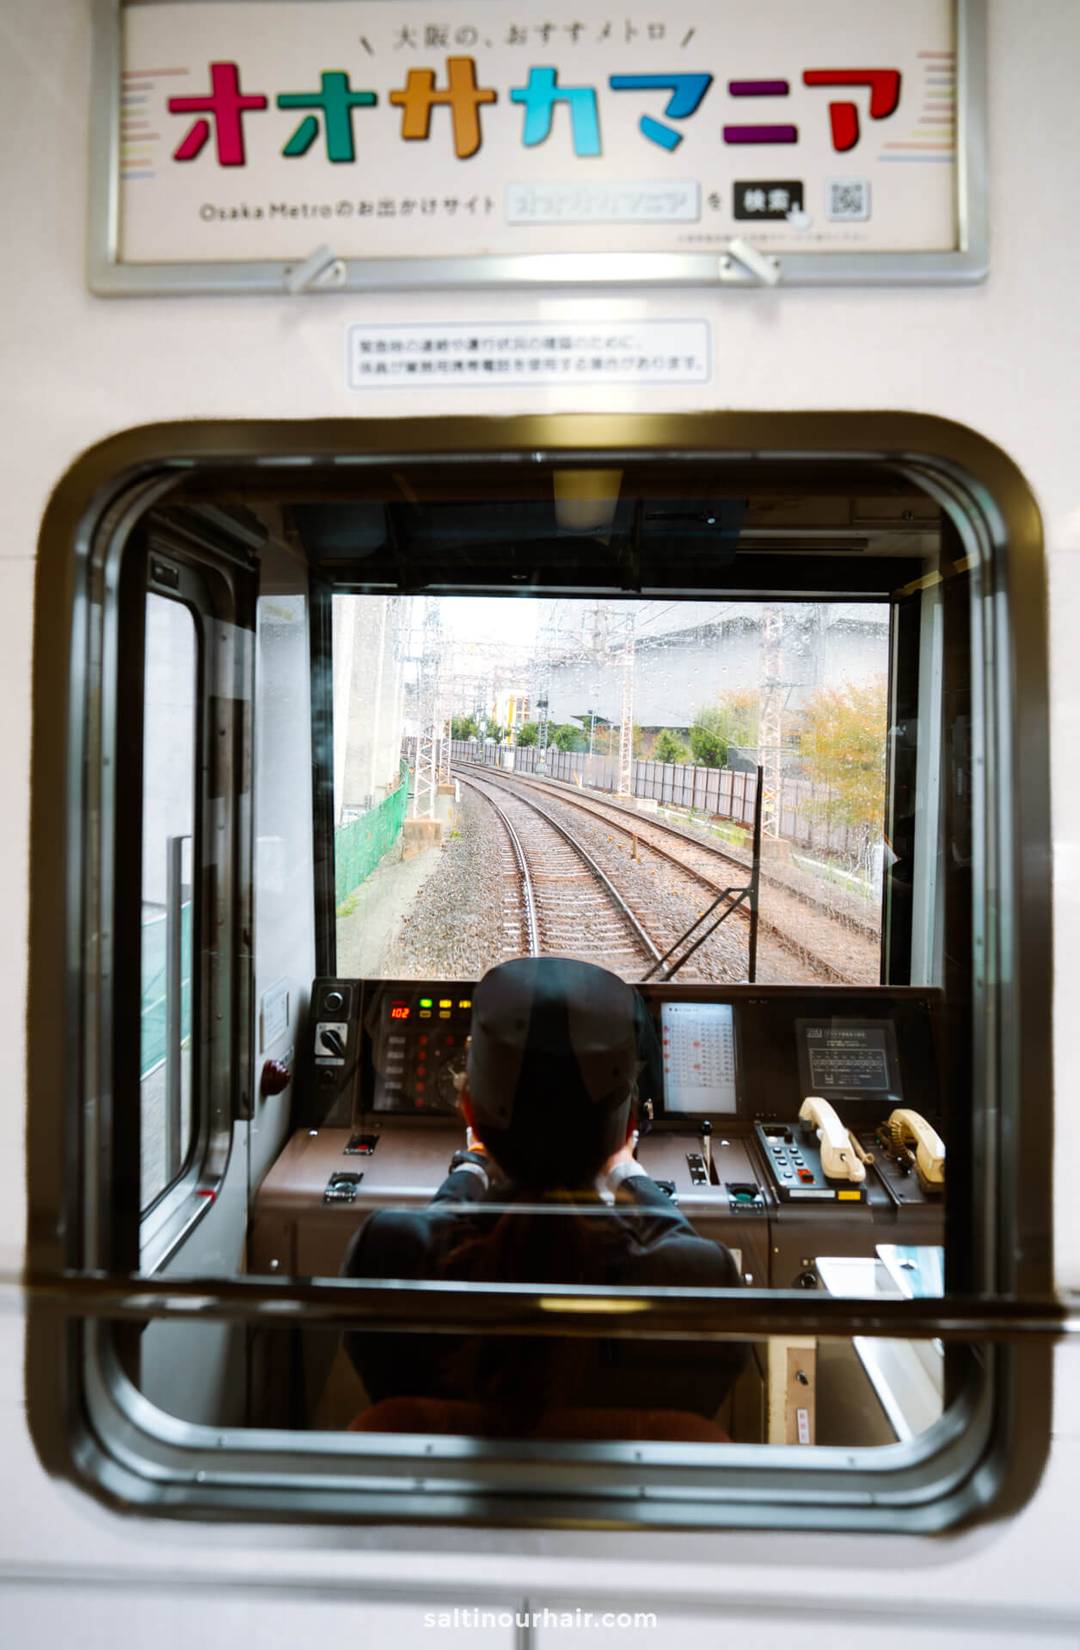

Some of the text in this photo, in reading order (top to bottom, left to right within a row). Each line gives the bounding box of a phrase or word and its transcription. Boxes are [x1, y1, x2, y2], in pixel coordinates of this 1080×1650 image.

[393, 20, 667, 50] 大阪の、おすすメトロ
[168, 56, 901, 167] オオサカマニア
[199, 202, 265, 222] Osaka
[391, 1007, 410, 1018] 102
